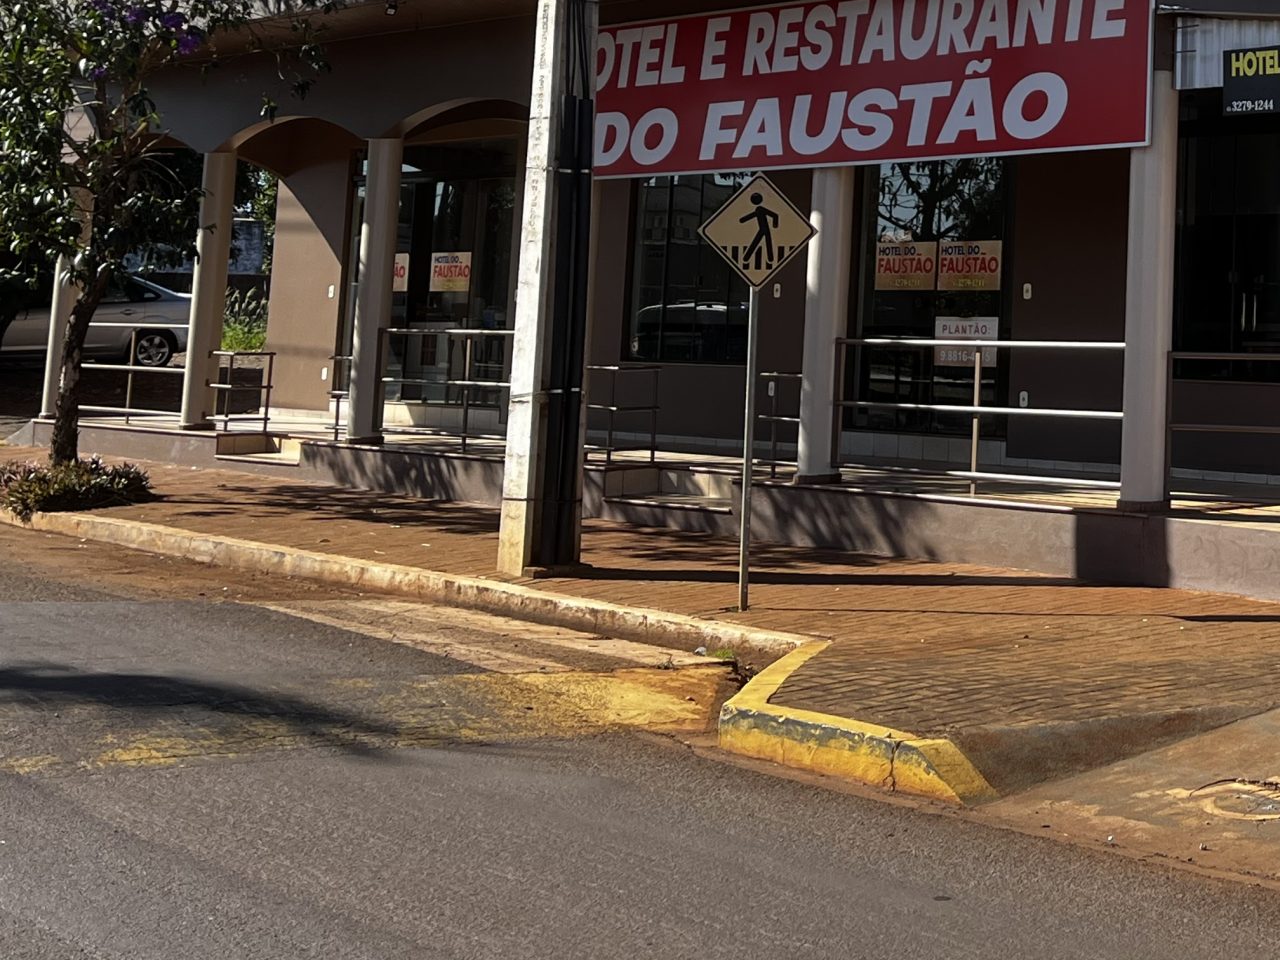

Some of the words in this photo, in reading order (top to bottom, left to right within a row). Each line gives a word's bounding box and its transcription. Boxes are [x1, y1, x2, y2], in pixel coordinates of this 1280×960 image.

[596, 22, 686, 92] OTEL
[700, 17, 732, 81] E
[594, 107, 679, 167] DO
[699, 58, 1069, 161] FAUSTÃO
[1231, 99, 1274, 112] 3279-1244
[878, 246, 902, 256] HOTEL
[904, 246, 916, 256] DO
[941, 246, 965, 256] HOTEL
[968, 245, 980, 255] DO
[432, 260, 470, 278] FAUSTÃO
[877, 253, 933, 273] FAUSTÃO
[940, 252, 998, 273] FAUSTÃO
